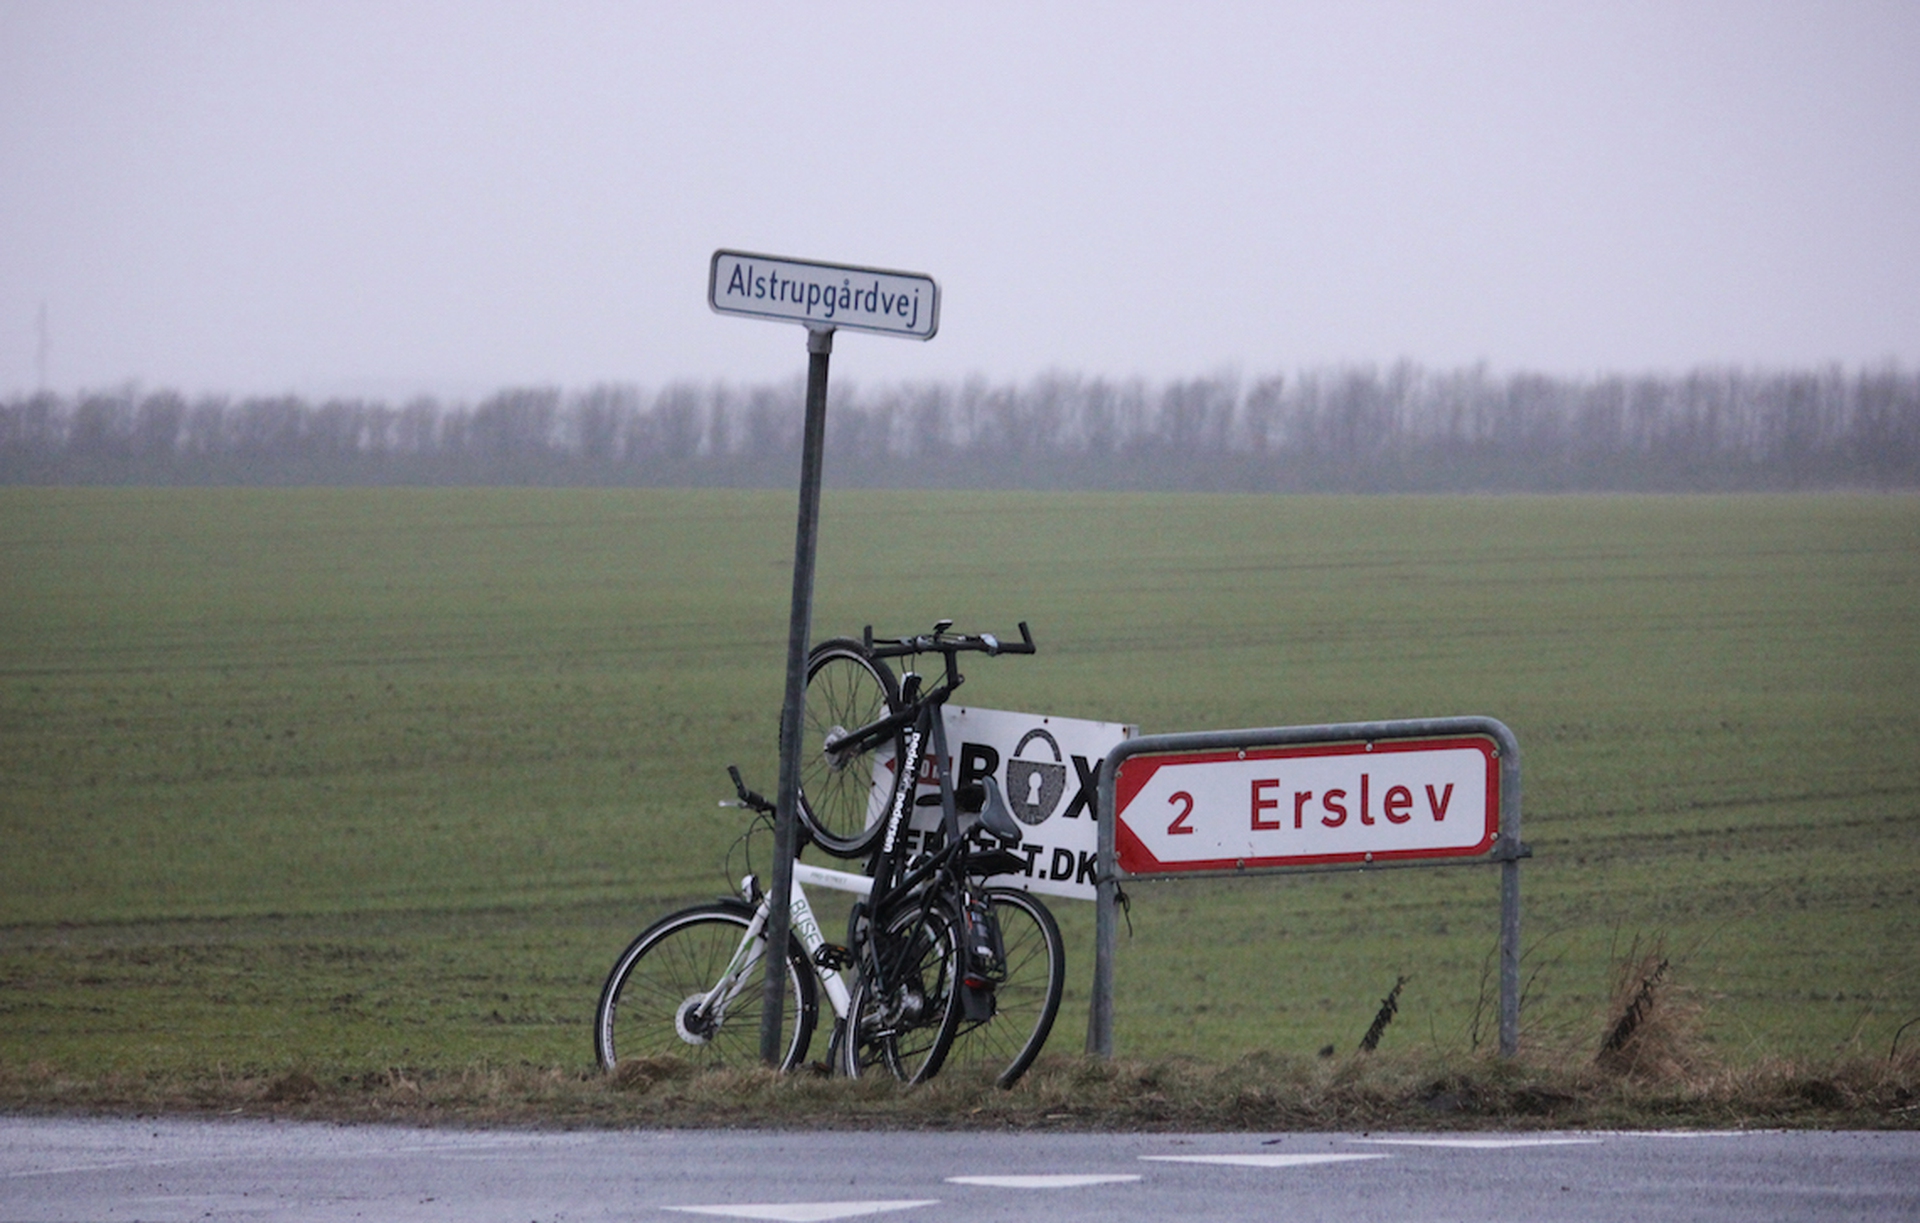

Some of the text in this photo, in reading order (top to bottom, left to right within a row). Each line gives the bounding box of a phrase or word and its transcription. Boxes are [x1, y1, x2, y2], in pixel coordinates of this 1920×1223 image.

[727, 263, 919, 328] Alstrupgårdvej
[1167, 773, 1454, 835] 2 Erslev
